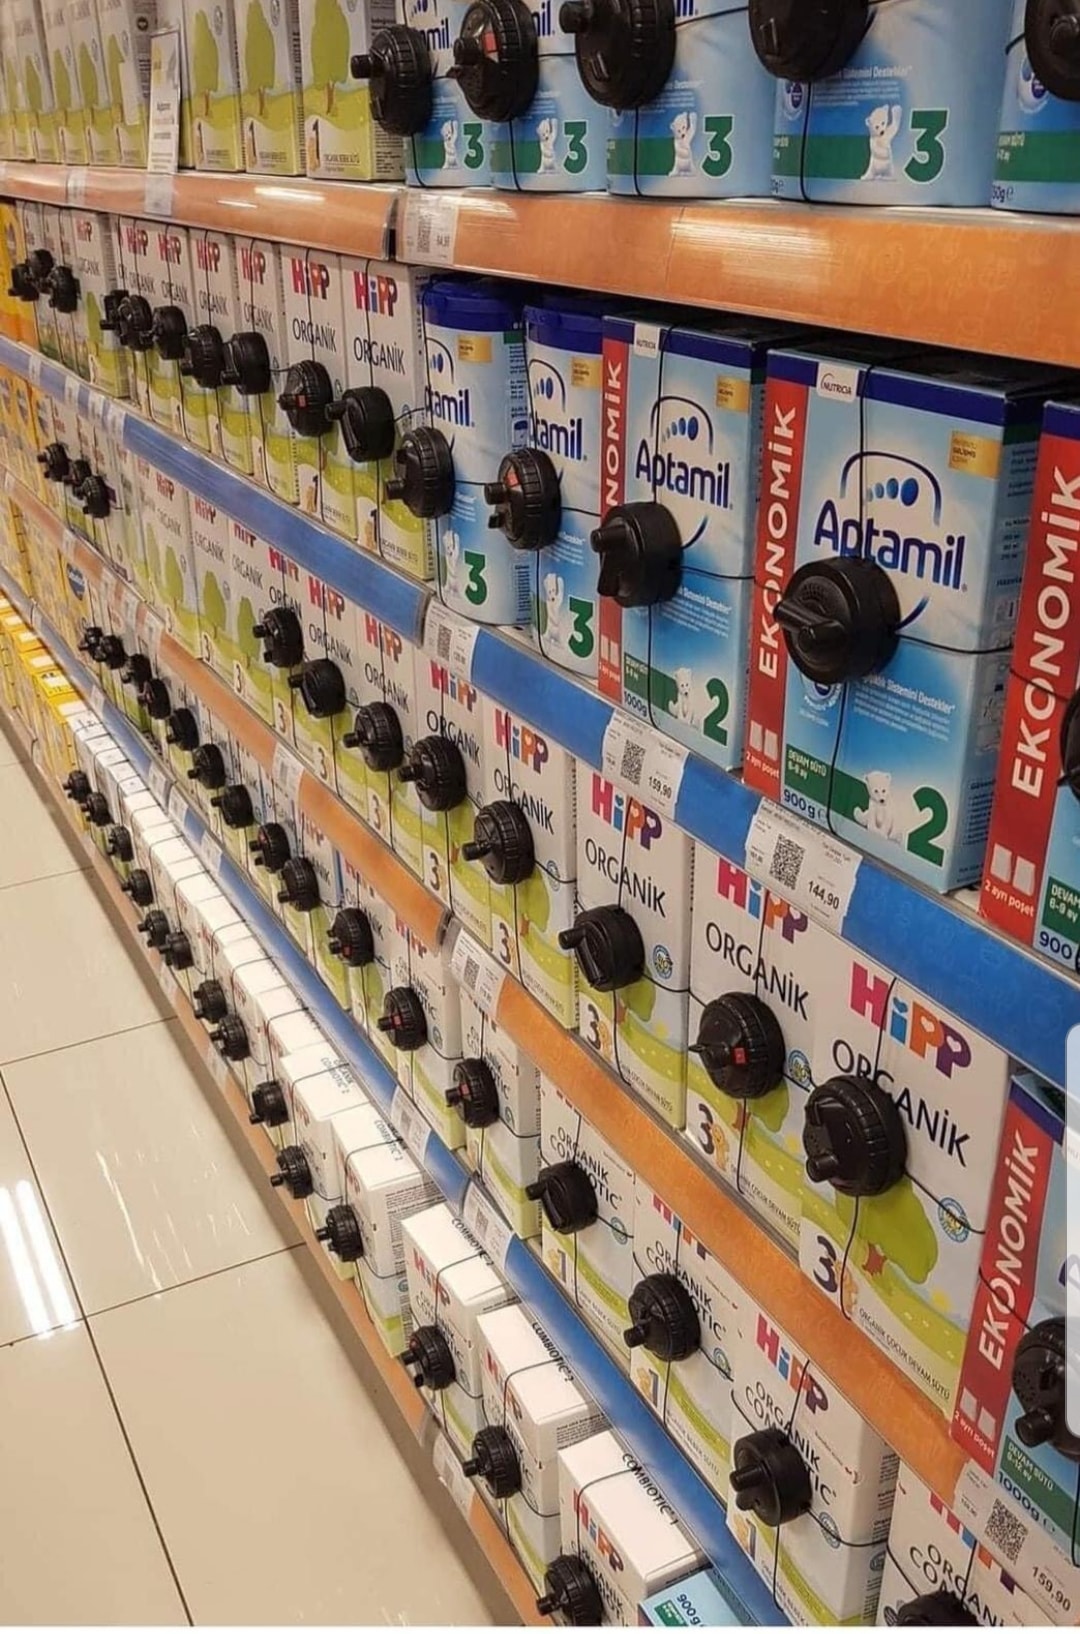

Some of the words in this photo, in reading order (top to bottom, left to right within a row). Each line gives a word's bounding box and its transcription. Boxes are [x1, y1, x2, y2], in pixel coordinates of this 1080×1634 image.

[312, 118, 320, 162] 1
[463, 123, 484, 169] 3
[564, 121, 588, 174] 3
[702, 116, 733, 177] 3
[904, 108, 949, 183] 3
[291, 257, 330, 300] HiPP
[353, 271, 398, 317] HiPP
[292, 318, 336, 352] ORGANİK
[353, 337, 406, 375] ORGANİK
[604, 361, 622, 506] NOMİK
[635, 439, 730, 509] Aptamil
[370, 508, 377, 542] 1
[814, 499, 966, 591] Aptamil
[464, 551, 488, 605] 3
[568, 596, 595, 658] 3
[1011, 465, 1080, 799] EKONOMİK
[430, 660, 477, 712] HiPP
[703, 677, 730, 747] 2
[278, 702, 286, 734] 3
[495, 708, 549, 775] HiPP
[319, 747, 328, 779] 3
[649, 776, 672, 799] 159,90
[373, 795, 381, 830] 3
[494, 768, 554, 830] ORGANİK
[592, 772, 662, 850] HiPP
[907, 786, 949, 868] 2
[430, 852, 440, 891] 3
[585, 838, 667, 918] ORGANİK
[809, 880, 840, 909] 144,90
[984, 880, 991, 892] 2
[1008, 896, 1035, 917] poşet
[718, 857, 808, 944] HiPP
[499, 922, 511, 965] 3
[706, 922, 810, 1022] ORGANİK
[587, 1004, 601, 1050] 3
[850, 961, 972, 1079] HiPP
[698, 1103, 716, 1155] 3
[813, 1235, 838, 1293] 3
[978, 1129, 1039, 1371] EKONOMİK
[756, 1312, 829, 1415] HiPP
[755, 1381, 820, 1473] ORGANİK
[622, 1453, 673, 1515] COMBIOTIC
[1008, 1442, 1034, 1473] DEVAM
[998, 1471, 1040, 1521] 1000g
[573, 1489, 624, 1572] HiPP
[1032, 1565, 1072, 1612] 159,90
